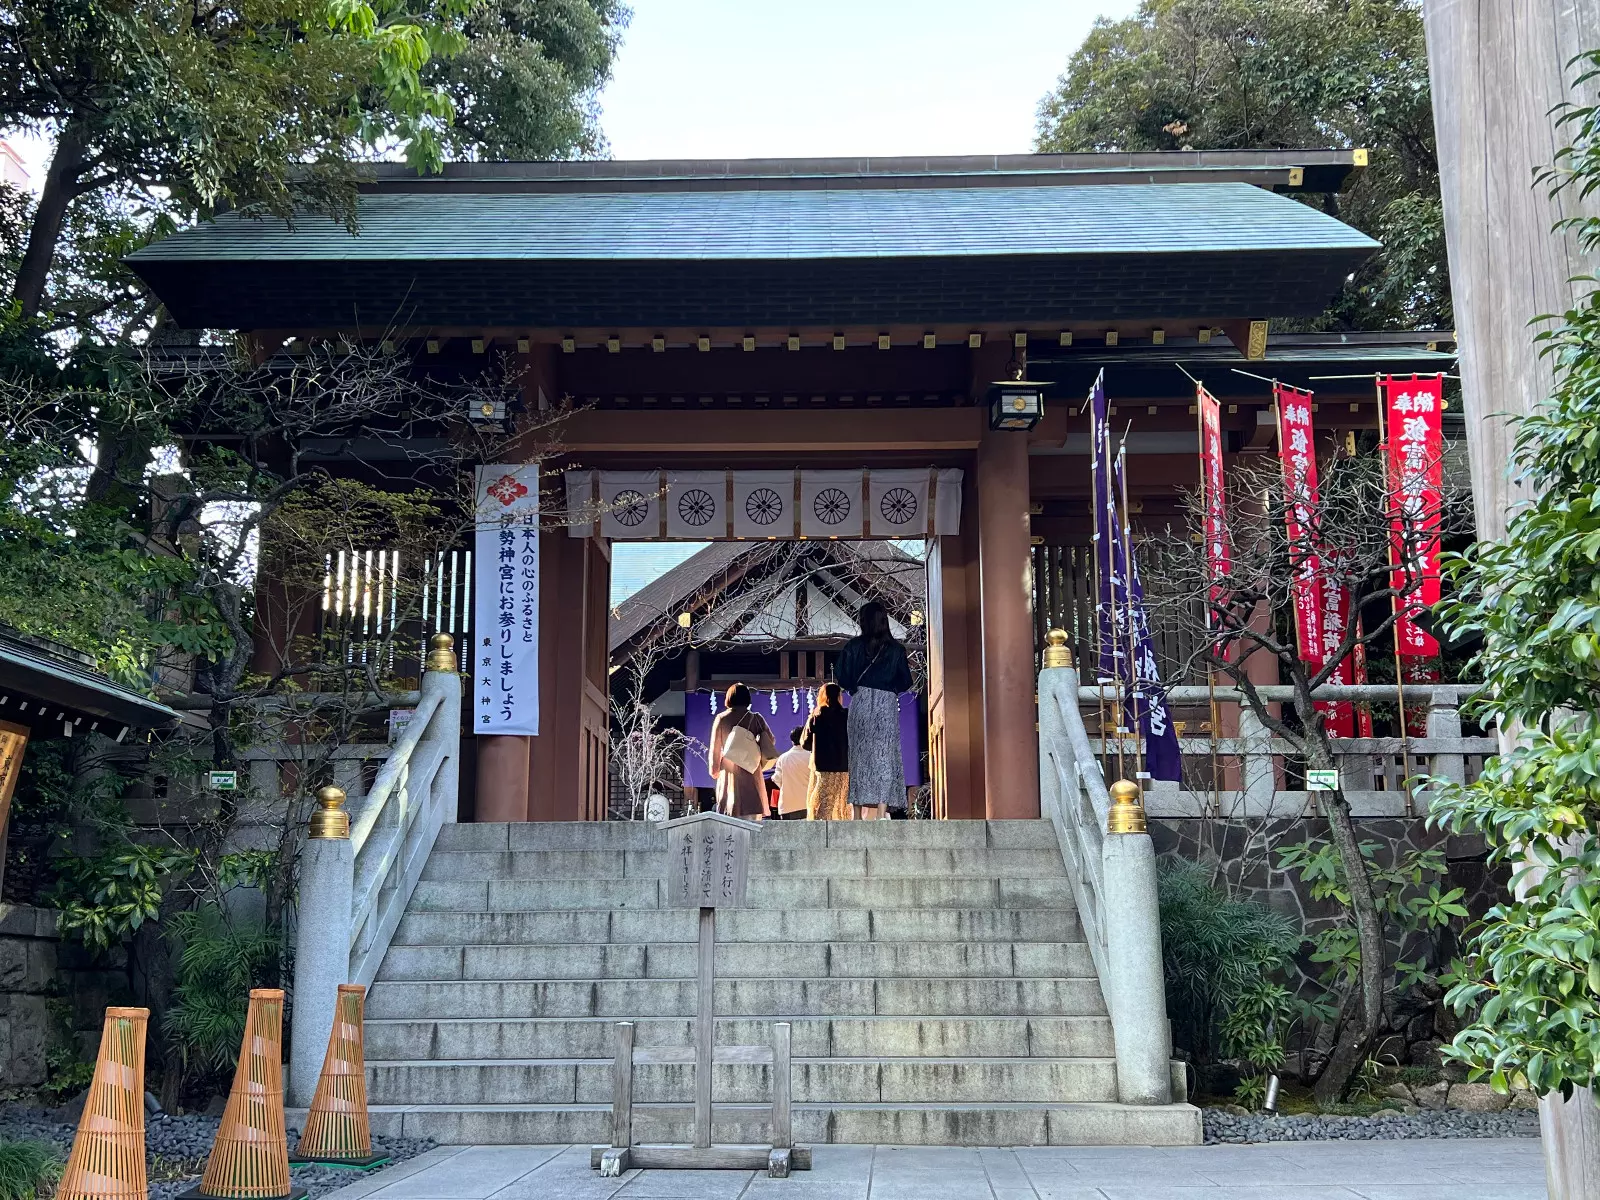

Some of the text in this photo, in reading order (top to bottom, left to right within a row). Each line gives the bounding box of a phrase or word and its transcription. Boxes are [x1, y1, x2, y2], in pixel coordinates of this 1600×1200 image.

[521, 513, 536, 643] 日本人の心のふるさと
[481, 637, 492, 724] 東京大神宮
[701, 834, 715, 898] 心身を清めて
[721, 834, 735, 898] 手水を行い
